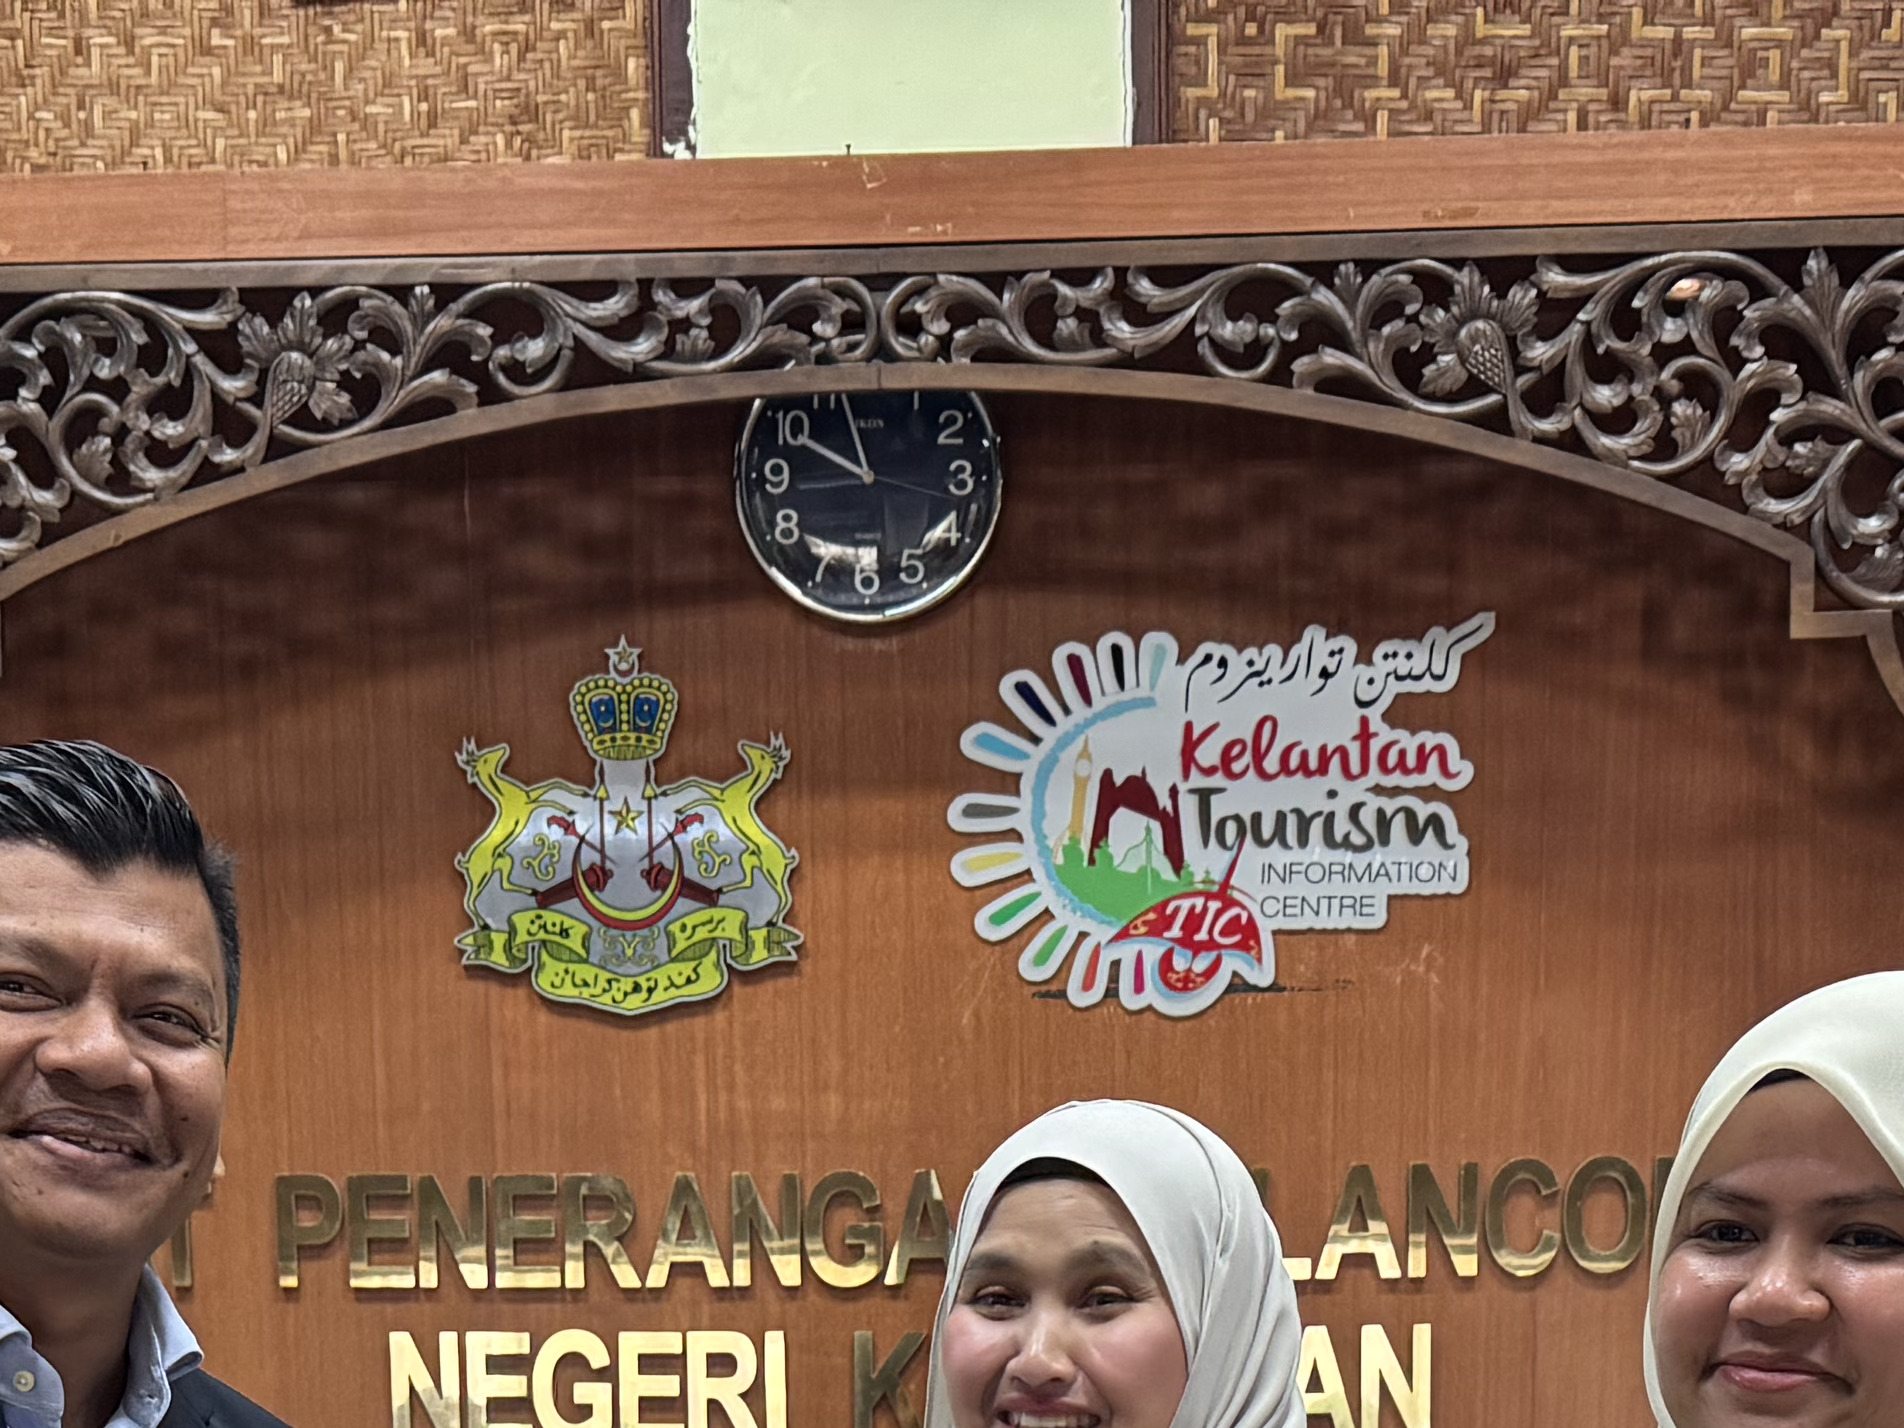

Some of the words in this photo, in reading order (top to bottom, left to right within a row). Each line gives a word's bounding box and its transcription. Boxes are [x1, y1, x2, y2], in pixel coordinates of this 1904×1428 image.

[775, 410, 809, 446] 10
[937, 409, 964, 444] 2
[763, 458, 790, 494] 9
[948, 460, 974, 495] 3
[774, 509, 800, 544] 8
[937, 510, 962, 546] 4
[854, 560, 880, 595] 6
[899, 549, 925, 584] 5
[1180, 714, 1462, 782] Kelantan
[1186, 786, 1456, 854] Tourism
[1260, 860, 1458, 885] INFORMATION
[1164, 897, 1249, 945] TIC
[1259, 895, 1377, 919] CENTRE
[275, 1167, 950, 1290] PENERANGA
